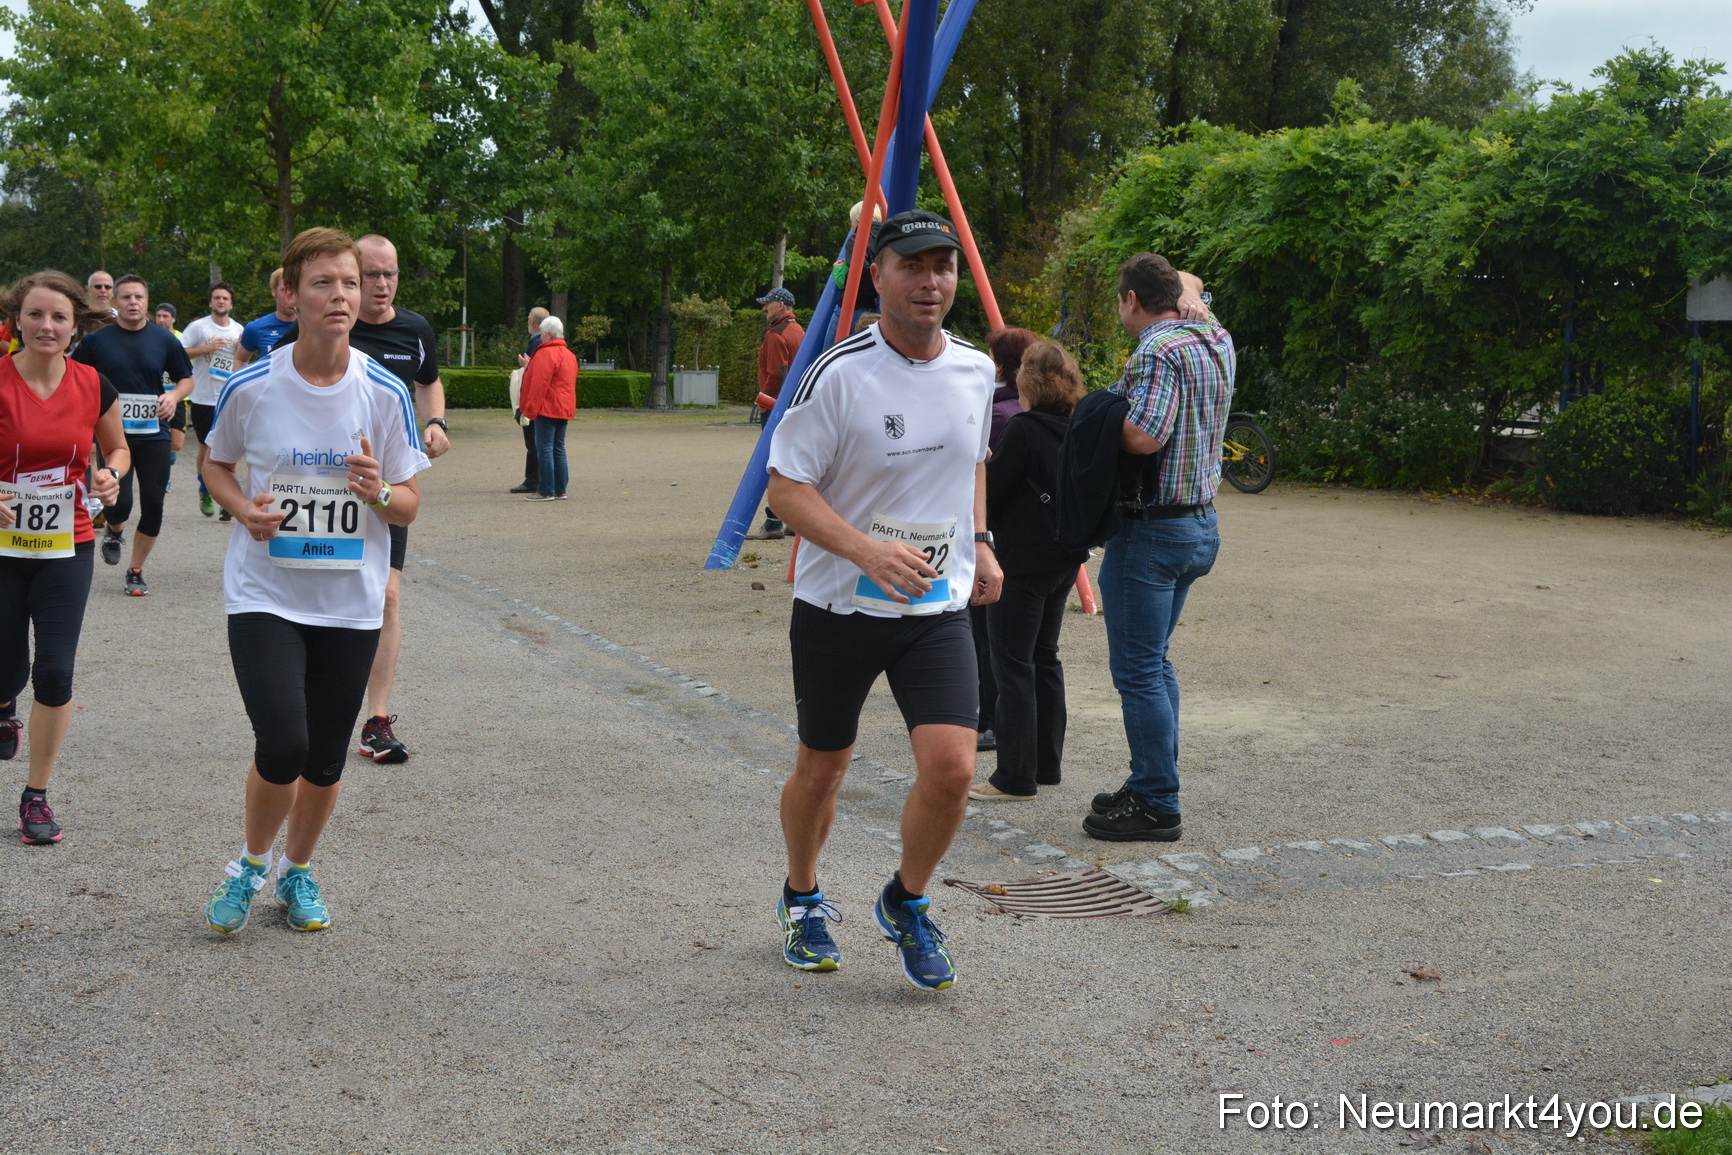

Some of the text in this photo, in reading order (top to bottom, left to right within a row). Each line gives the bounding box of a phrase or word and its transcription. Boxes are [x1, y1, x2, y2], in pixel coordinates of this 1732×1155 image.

[902, 221, 941, 234] mares
[123, 404, 157, 419] 2033
[293, 448, 354, 467] heinlot
[30, 474, 53, 483] DEHN
[25, 492, 63, 501] Neumarkt
[272, 483, 353, 496] PARTL Neumarkt
[11, 503, 60, 531] 182
[279, 498, 359, 534] 2110
[872, 523, 948, 541] PARTL Neumarkt
[12, 535, 53, 549] Martina
[302, 542, 335, 556] Anita
